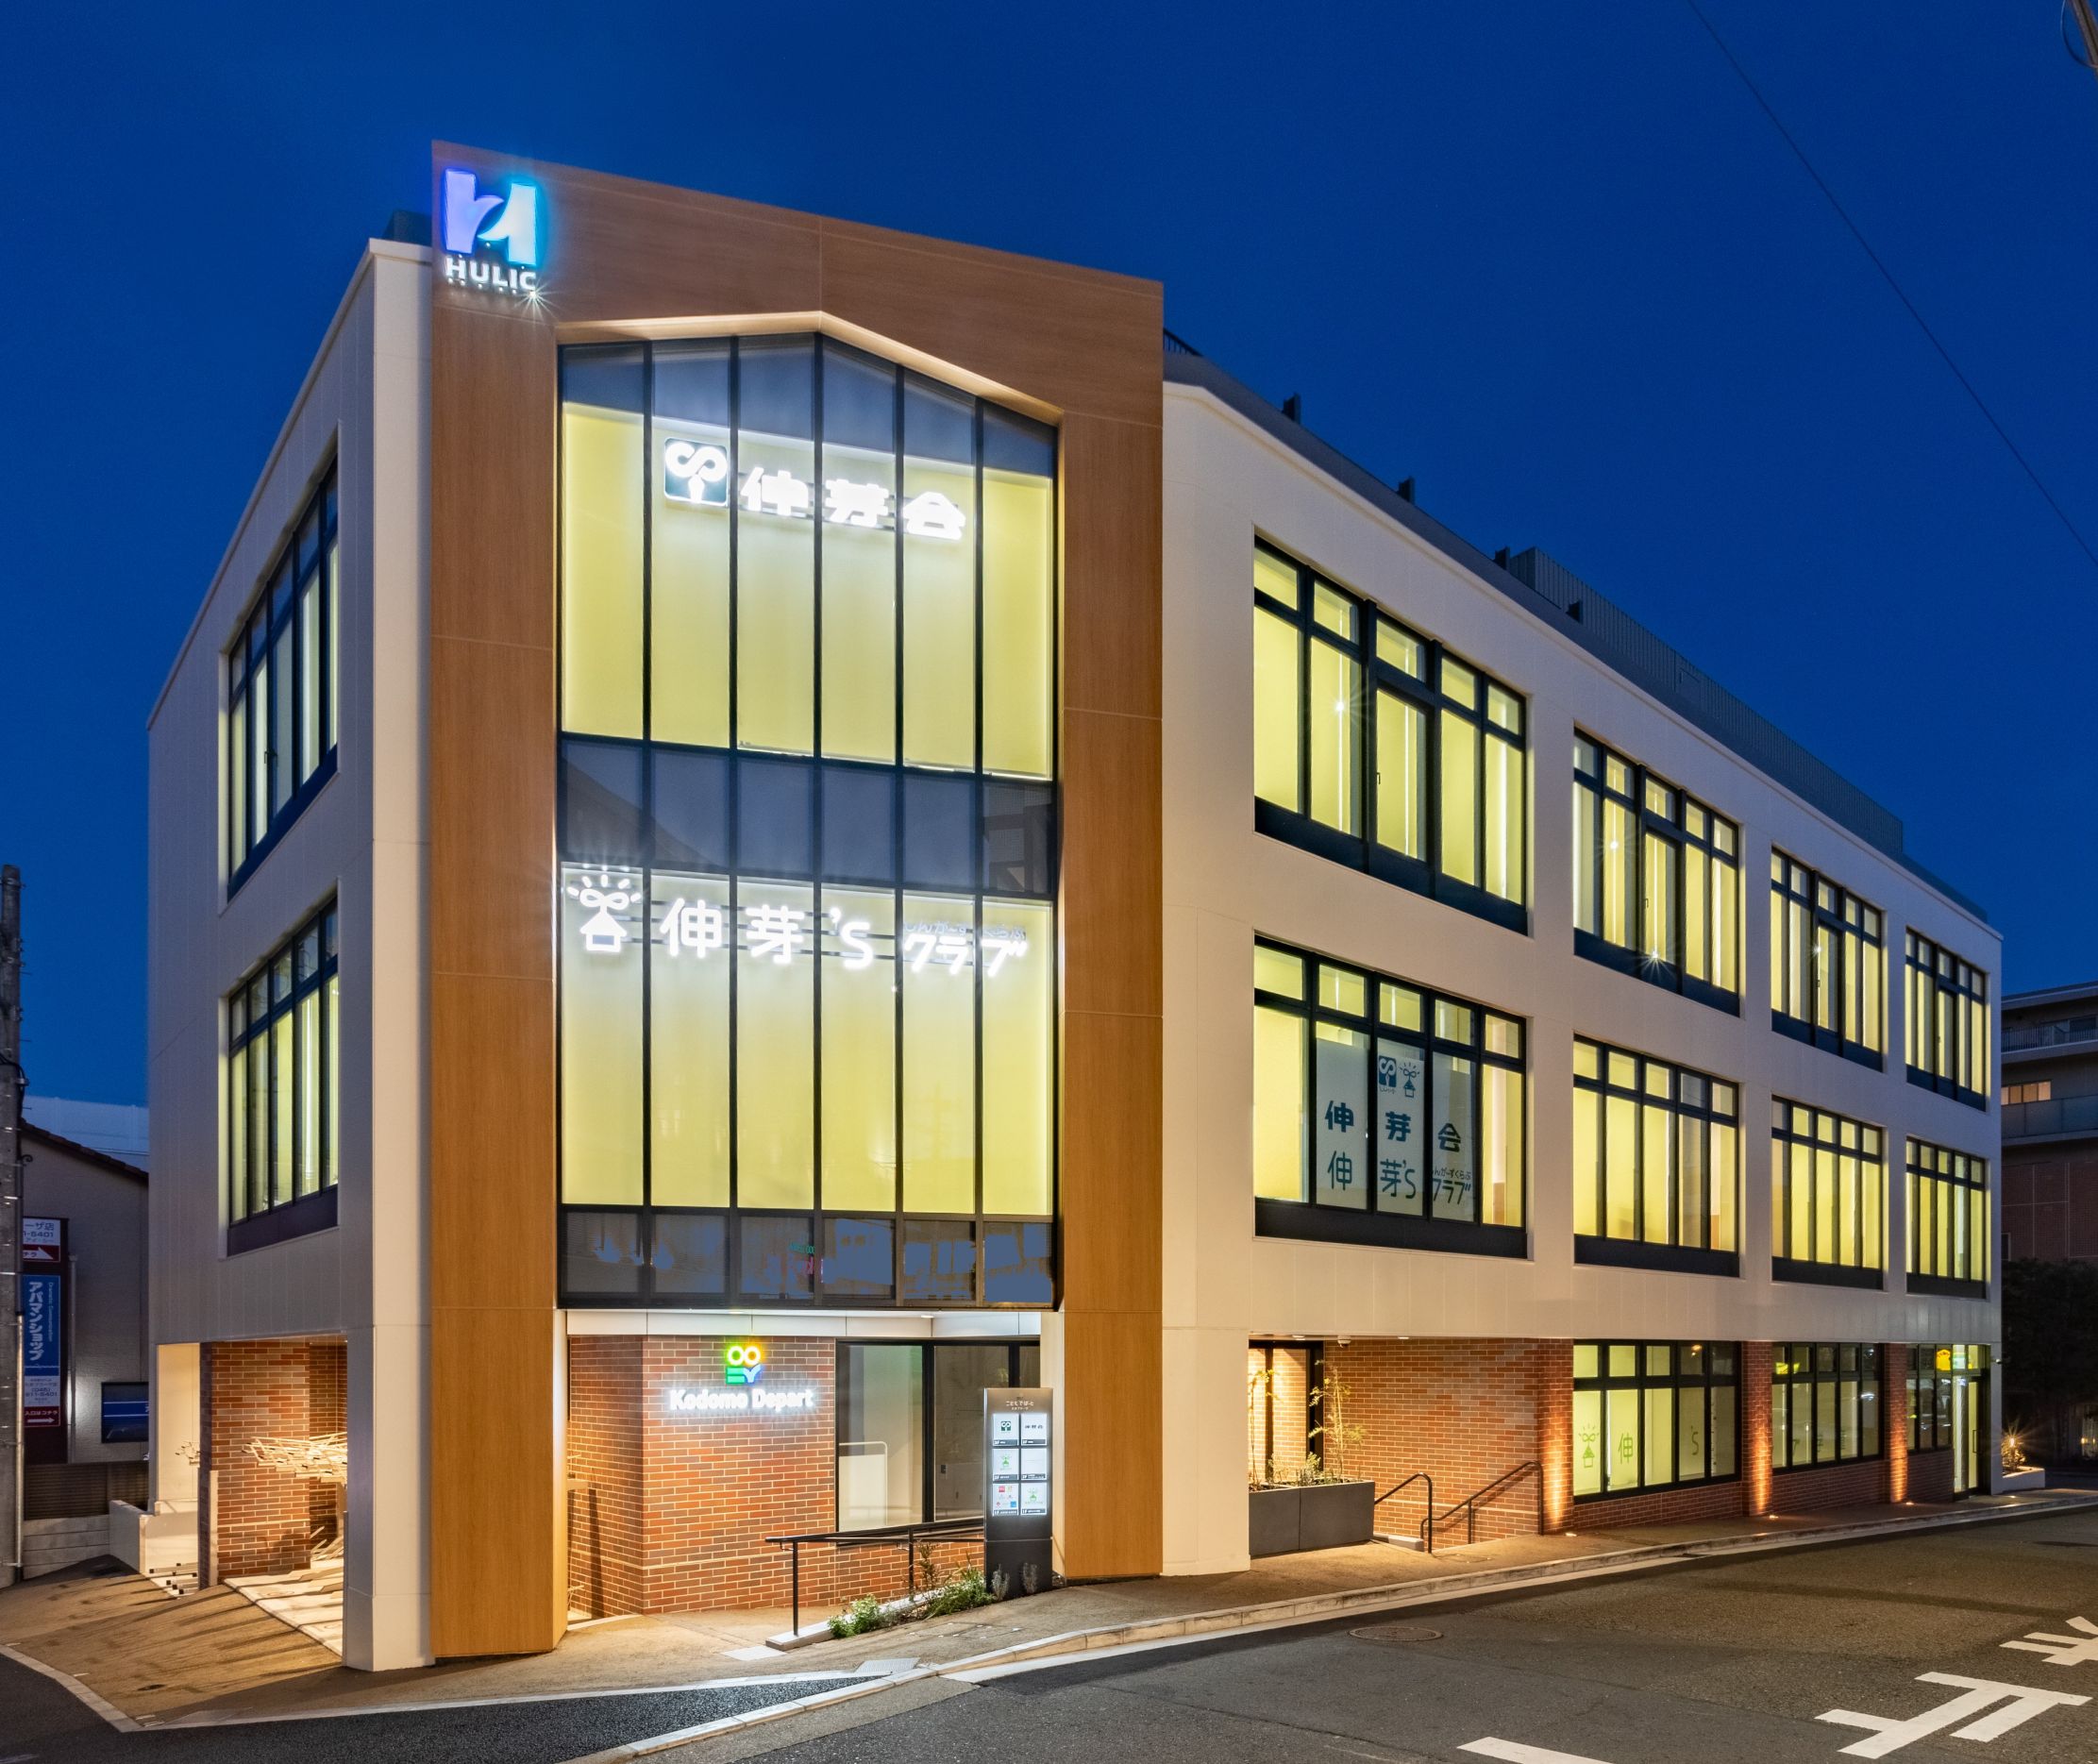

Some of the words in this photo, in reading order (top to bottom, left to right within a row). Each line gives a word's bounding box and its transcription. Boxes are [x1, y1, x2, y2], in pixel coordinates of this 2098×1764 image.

[445, 257, 537, 291] HULIC
[741, 467, 966, 541] 伸芽会
[1325, 1100, 1461, 1152] 伸芽会
[28, 1282, 43, 1360] アパマンショップ
[670, 1389, 748, 1410] Kodomo
[752, 1388, 814, 1413] Depart
